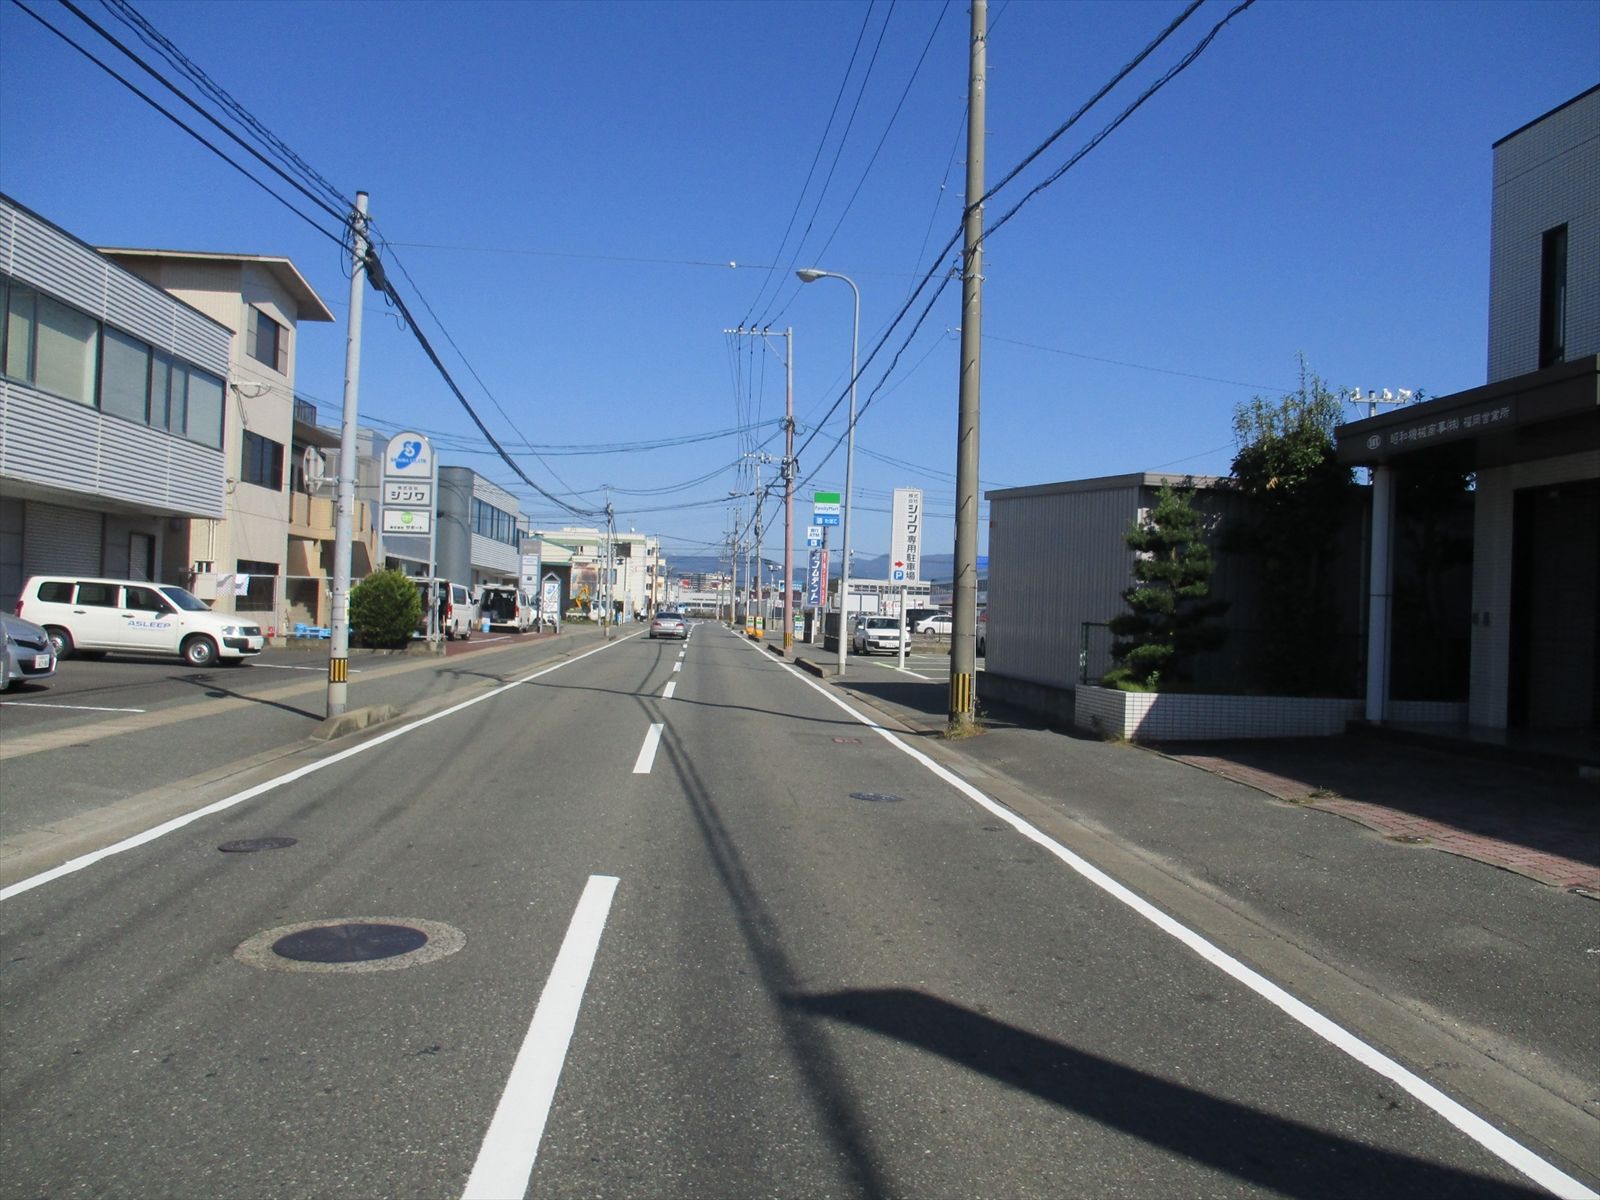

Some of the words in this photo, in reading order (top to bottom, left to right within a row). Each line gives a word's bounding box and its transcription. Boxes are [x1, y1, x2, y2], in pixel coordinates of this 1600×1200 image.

[391, 491, 425, 501] シンワ
[906, 505, 918, 580] シンワ専用駐車場
[128, 620, 171, 629] ASLEEP
